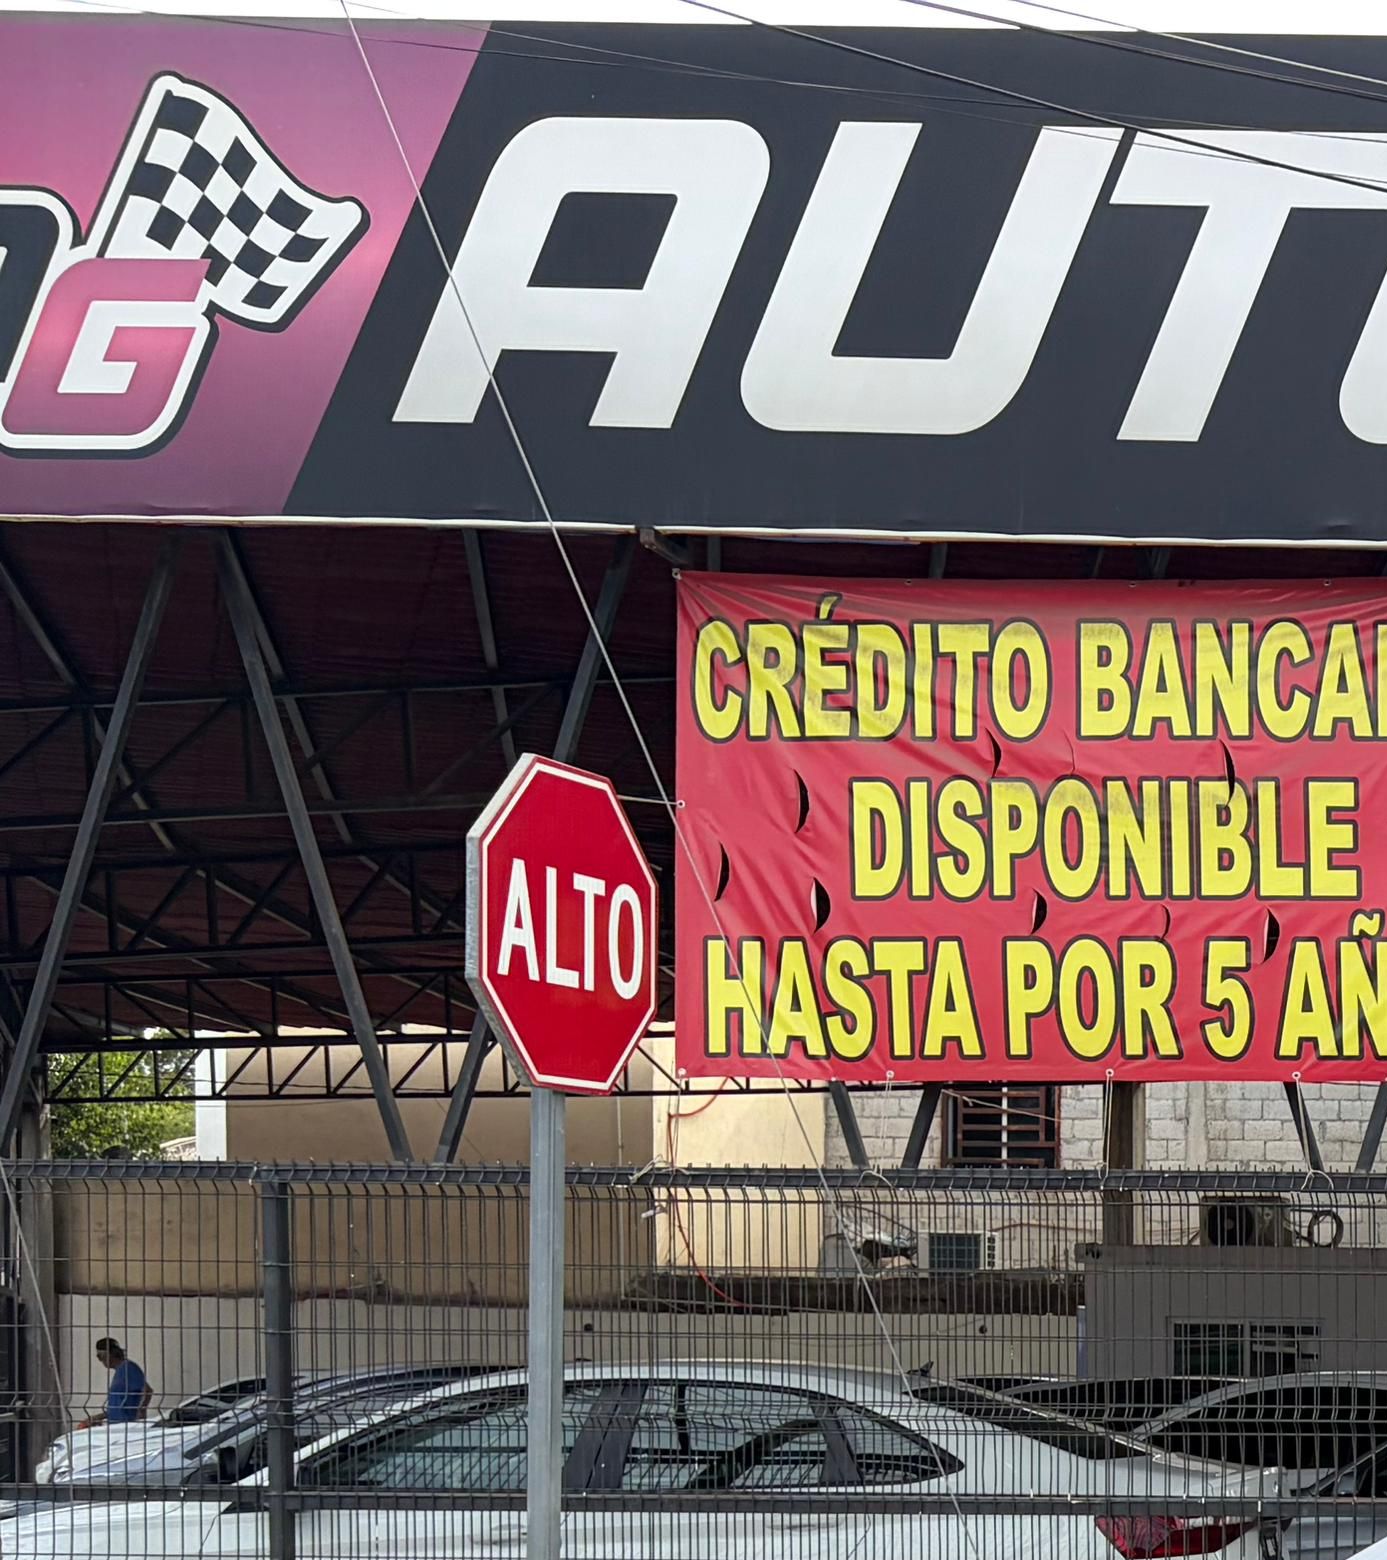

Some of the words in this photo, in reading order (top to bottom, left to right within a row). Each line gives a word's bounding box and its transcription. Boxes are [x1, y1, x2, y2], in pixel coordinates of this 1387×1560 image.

[690, 591, 1050, 744] CRÉDITO
[848, 775, 1363, 902] DISPONIBLE
[497, 857, 644, 1000] ALTO
[701, 934, 985, 1061] HASTA
[1001, 934, 1184, 1061] POR
[1200, 933, 1257, 1061] 5
